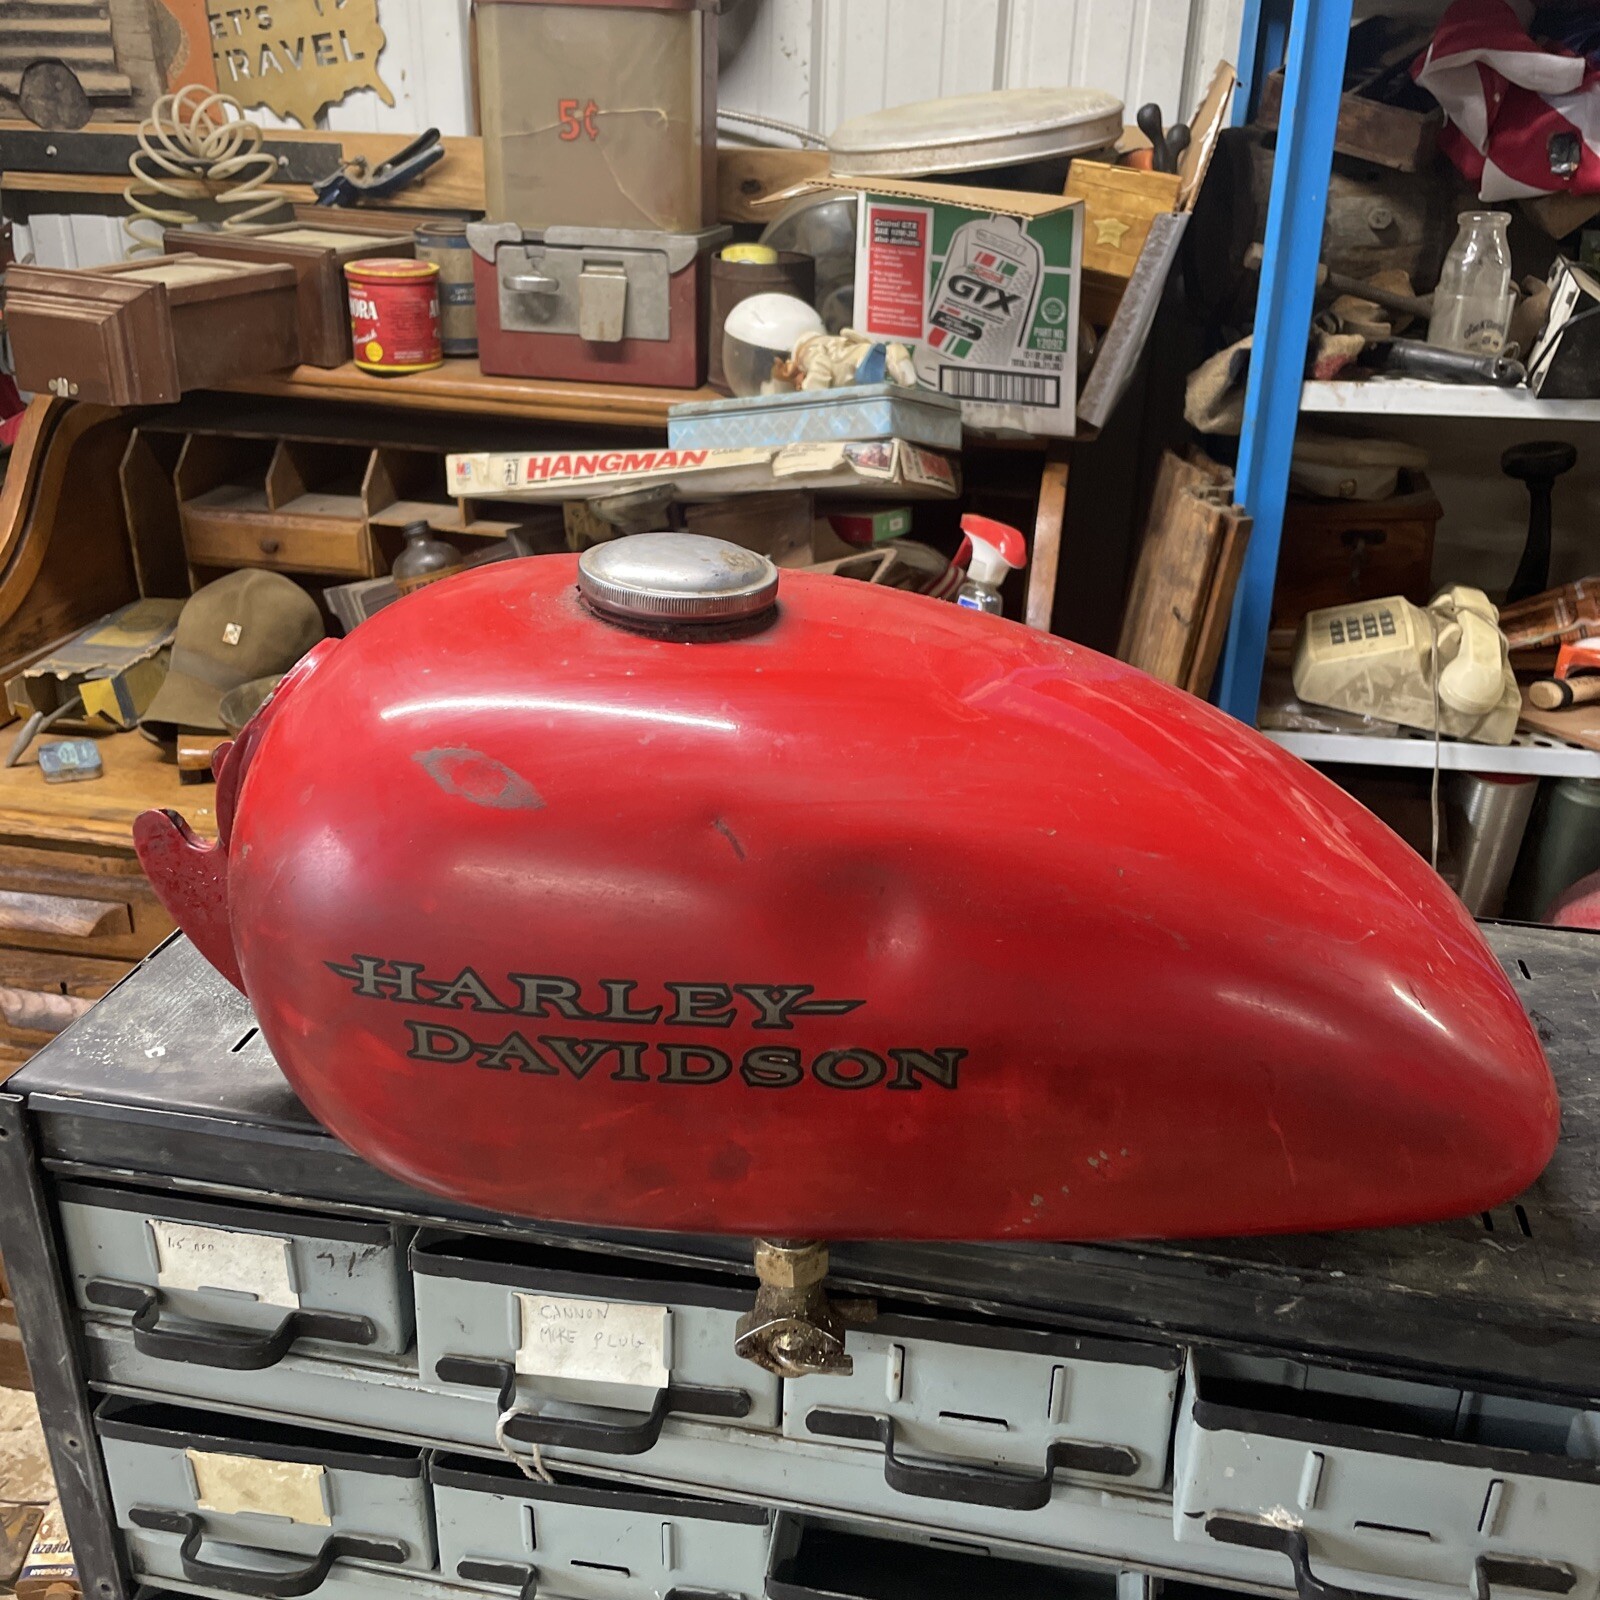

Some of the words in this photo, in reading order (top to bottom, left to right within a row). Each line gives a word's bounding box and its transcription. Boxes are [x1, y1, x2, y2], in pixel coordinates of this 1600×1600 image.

[208, 5, 273, 39] ET'S
[213, 30, 365, 82] RAVEL
[558, 99, 600, 141] 5¢
[948, 275, 1021, 316] GTX
[525, 450, 709, 479] HANGMAN
[345, 953, 835, 1030] HARLEY
[402, 1019, 969, 1091] DAVIDSON
[540, 1302, 609, 1320] CANNON
